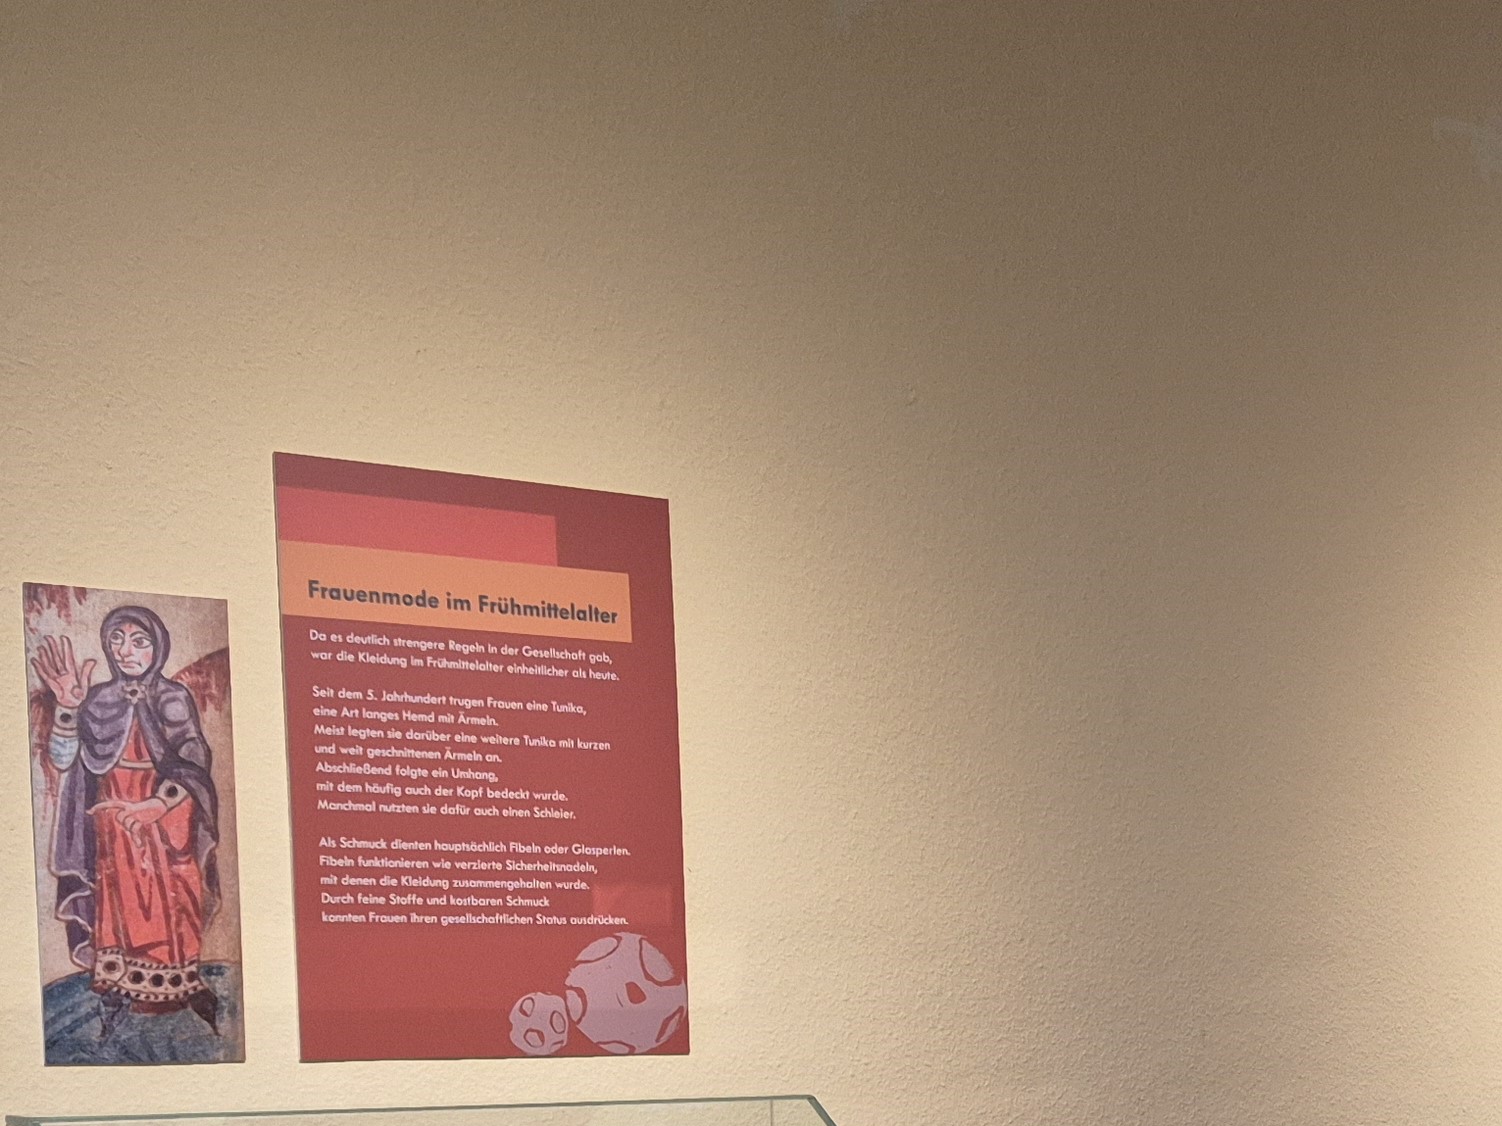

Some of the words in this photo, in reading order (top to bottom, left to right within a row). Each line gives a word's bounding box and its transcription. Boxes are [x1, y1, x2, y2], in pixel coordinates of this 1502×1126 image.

[307, 579, 439, 607] Frauenmode
[446, 591, 471, 611] im
[478, 595, 617, 623] Frühmittelalter
[308, 628, 327, 641] Da
[329, 633, 343, 642] es
[345, 632, 390, 645] deutlich
[392, 637, 445, 651] strengere
[447, 639, 485, 654] Regeln
[487, 643, 498, 653] in
[500, 644, 518, 655] der
[521, 645, 586, 660] Gesellschaft
[310, 651, 332, 660] war
[335, 650, 355, 662] die
[357, 651, 408, 668] Kleidung
[410, 655, 424, 666] im
[426, 656, 503, 672] Frühmittelalter
[506, 663, 568, 676] einheitlicher
[571, 667, 587, 678] als
[312, 684, 334, 697] Seit
[337, 687, 363, 699] dem
[381, 690, 446, 704] Jahrhundert
[448, 696, 484, 709] trugen
[486, 696, 523, 709] Frauen
[525, 700, 548, 711] eine
[312, 705, 337, 717] eine
[340, 706, 359, 717] Art
[361, 708, 399, 722] langes
[401, 710, 435, 722] Hemd
[437, 712, 455, 723] mit
[313, 724, 345, 735] Meist
[347, 725, 384, 739] legten
[386, 727, 402, 739] sie
[405, 729, 450, 741] darüber
[454, 731, 477, 743] eine
[480, 734, 520, 745] weitere
[524, 734, 556, 747] Tunika
[558, 737, 574, 748] mit
[576, 738, 611, 750] kurzen
[314, 743, 336, 754] und
[339, 744, 363, 755] weit
[366, 746, 441, 759] geschnittenen
[443, 746, 483, 761] Ärmeln
[315, 761, 392, 775] Abschließend
[394, 764, 429, 779] folgte
[431, 767, 449, 778] ein
[315, 780, 334, 791] mit
[336, 780, 362, 792] dem
[364, 782, 402, 797] häufig
[404, 784, 431, 795] auch
[434, 784, 453, 796] der
[456, 785, 483, 799] Kopf
[486, 787, 530, 799] bedeckt
[316, 799, 376, 811] Manchmal
[378, 803, 419, 813] nutzten
[421, 803, 437, 814] sie
[439, 803, 470, 815] dafür
[473, 805, 499, 816] auch
[501, 806, 531, 817] einen
[318, 836, 336, 848] Als
[339, 836, 387, 849] Schmuck
[390, 838, 432, 850] dienten
[433, 840, 507, 852] hauptsächlich
[508, 841, 541, 853] Fibeln
[543, 843, 568, 854] oder
[318, 854, 355, 866] Fibeln
[357, 856, 429, 868] funktionieren
[432, 858, 451, 869] wie
[454, 859, 503, 870] verzierte
[319, 874, 338, 884] mit
[340, 874, 376, 885] denen
[378, 875, 398, 886] die
[400, 875, 449, 889] Kleidung
[452, 878, 552, 890] zusammengehalten
[320, 892, 354, 904] Durch
[357, 892, 386, 904] feine
[389, 893, 423, 905] Stoffe
[426, 894, 447, 905] und
[449, 894, 503, 906] kostbaren
[505, 895, 550, 907] Schmuck
[321, 911, 366, 922] konnten
[368, 911, 407, 923] Frauen
[409, 912, 438, 923] ihren
[440, 912, 533, 925] gesellschaftlichen
[535, 913, 567, 925] Status
